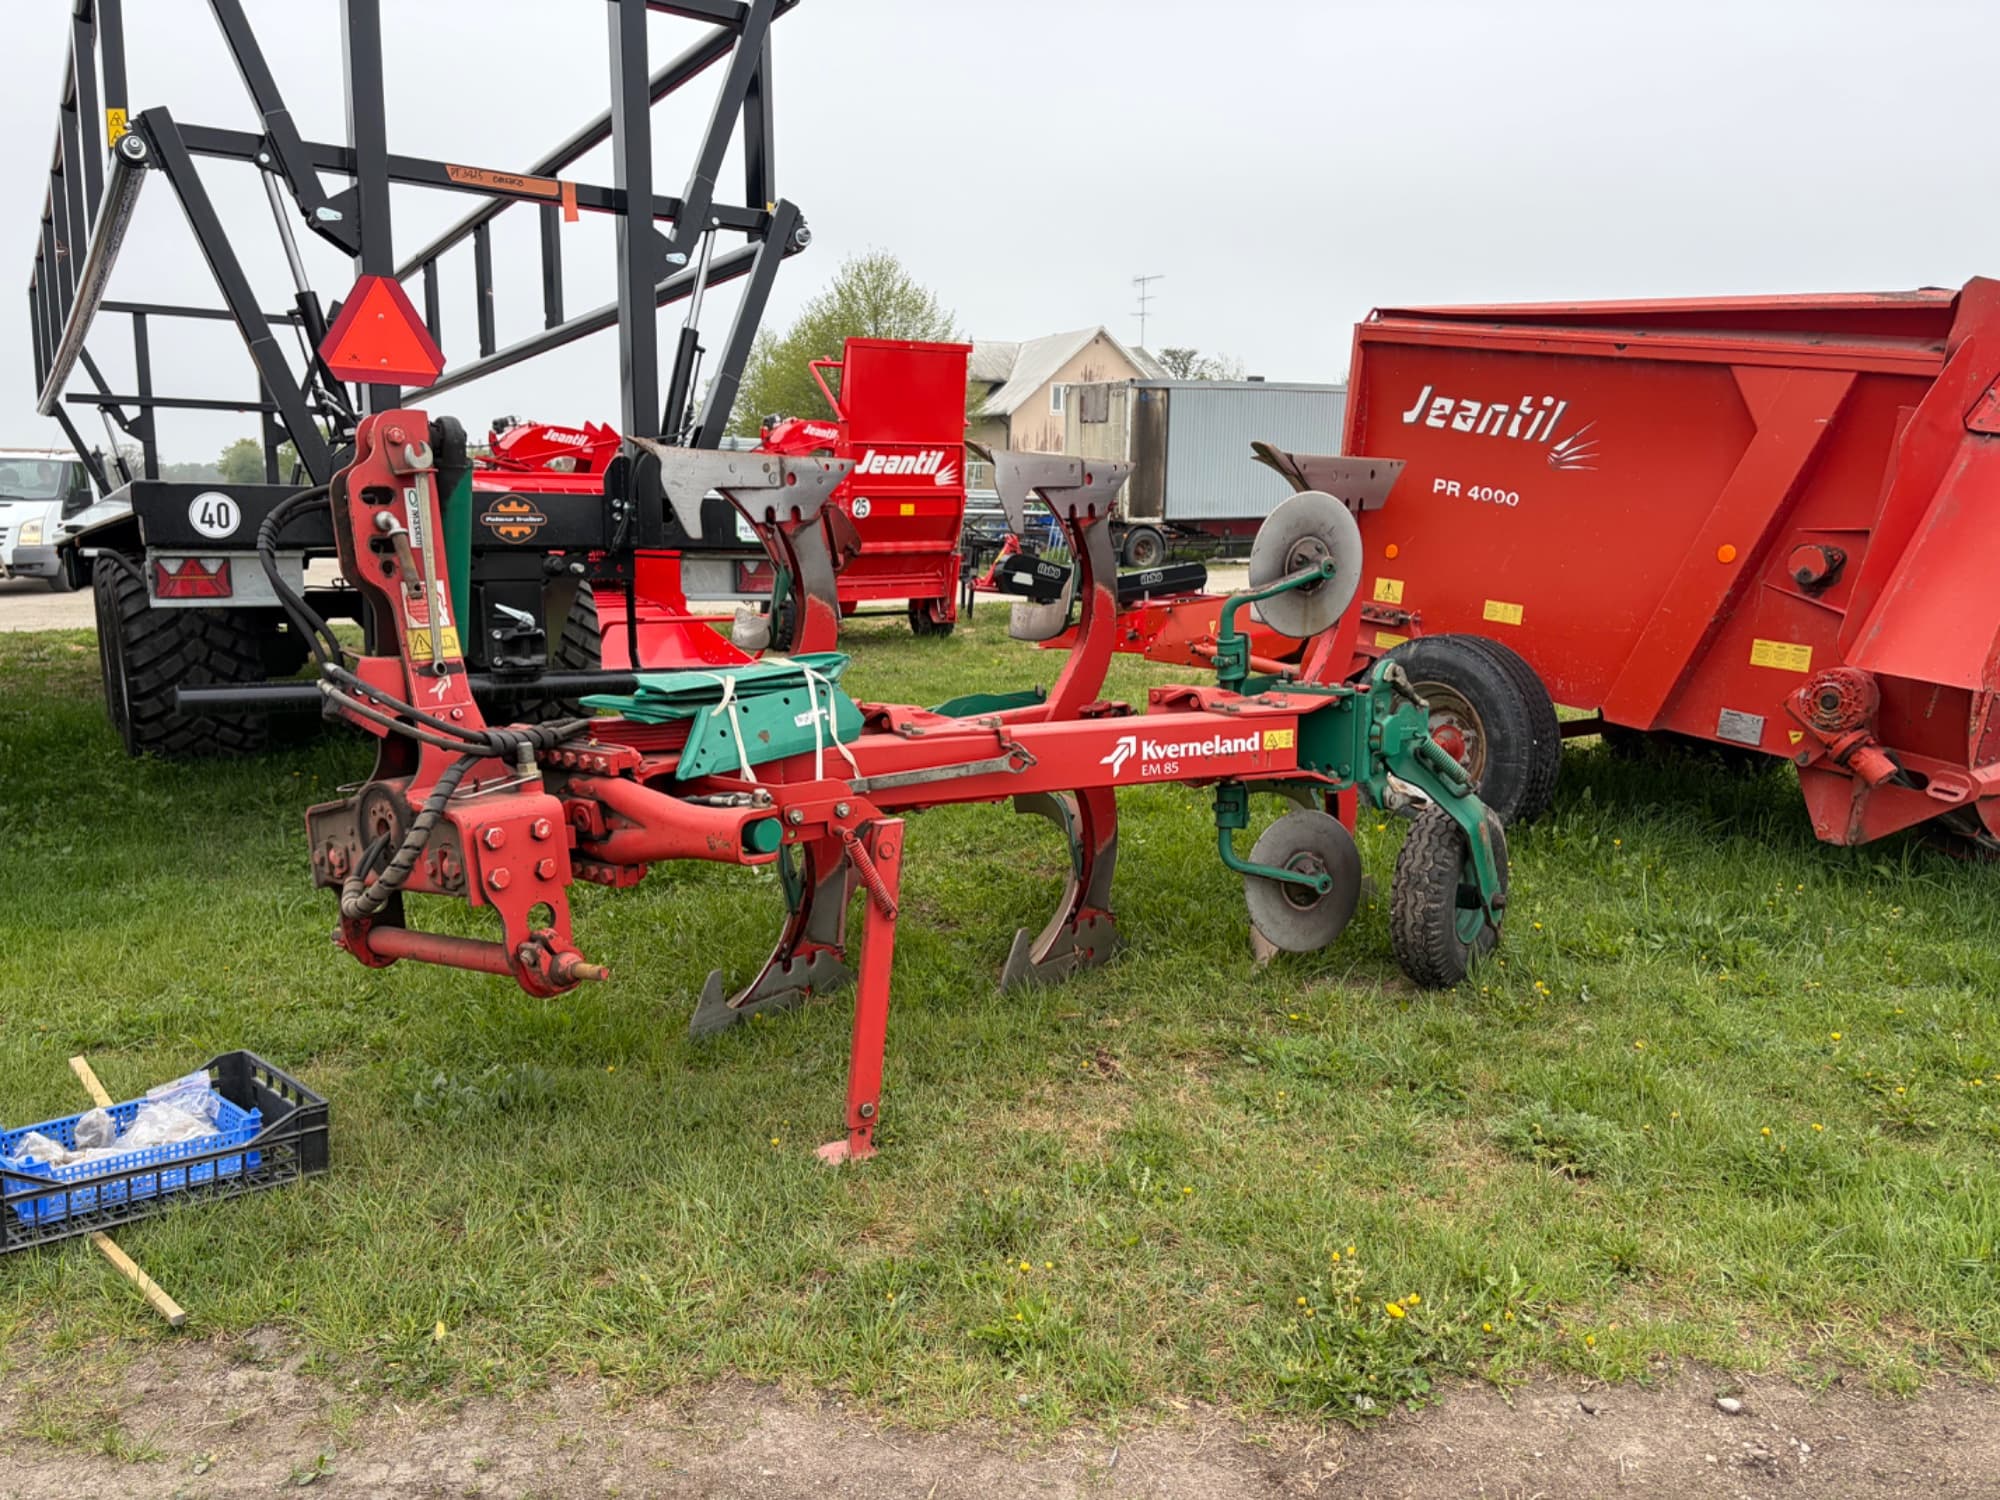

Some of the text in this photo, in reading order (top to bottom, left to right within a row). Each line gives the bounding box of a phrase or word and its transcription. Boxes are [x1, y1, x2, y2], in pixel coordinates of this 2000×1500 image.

[1403, 385, 1567, 442] Jeantil
[542, 428, 589, 447] Jeantil
[803, 424, 838, 439] Jeantil
[854, 450, 945, 475] Jeantil
[1433, 478, 1519, 507] PR 4000
[200, 502, 230, 529] 40
[855, 499, 868, 516] 25
[1141, 731, 1260, 760] Kverneland
[1141, 761, 1179, 776] EM 85
